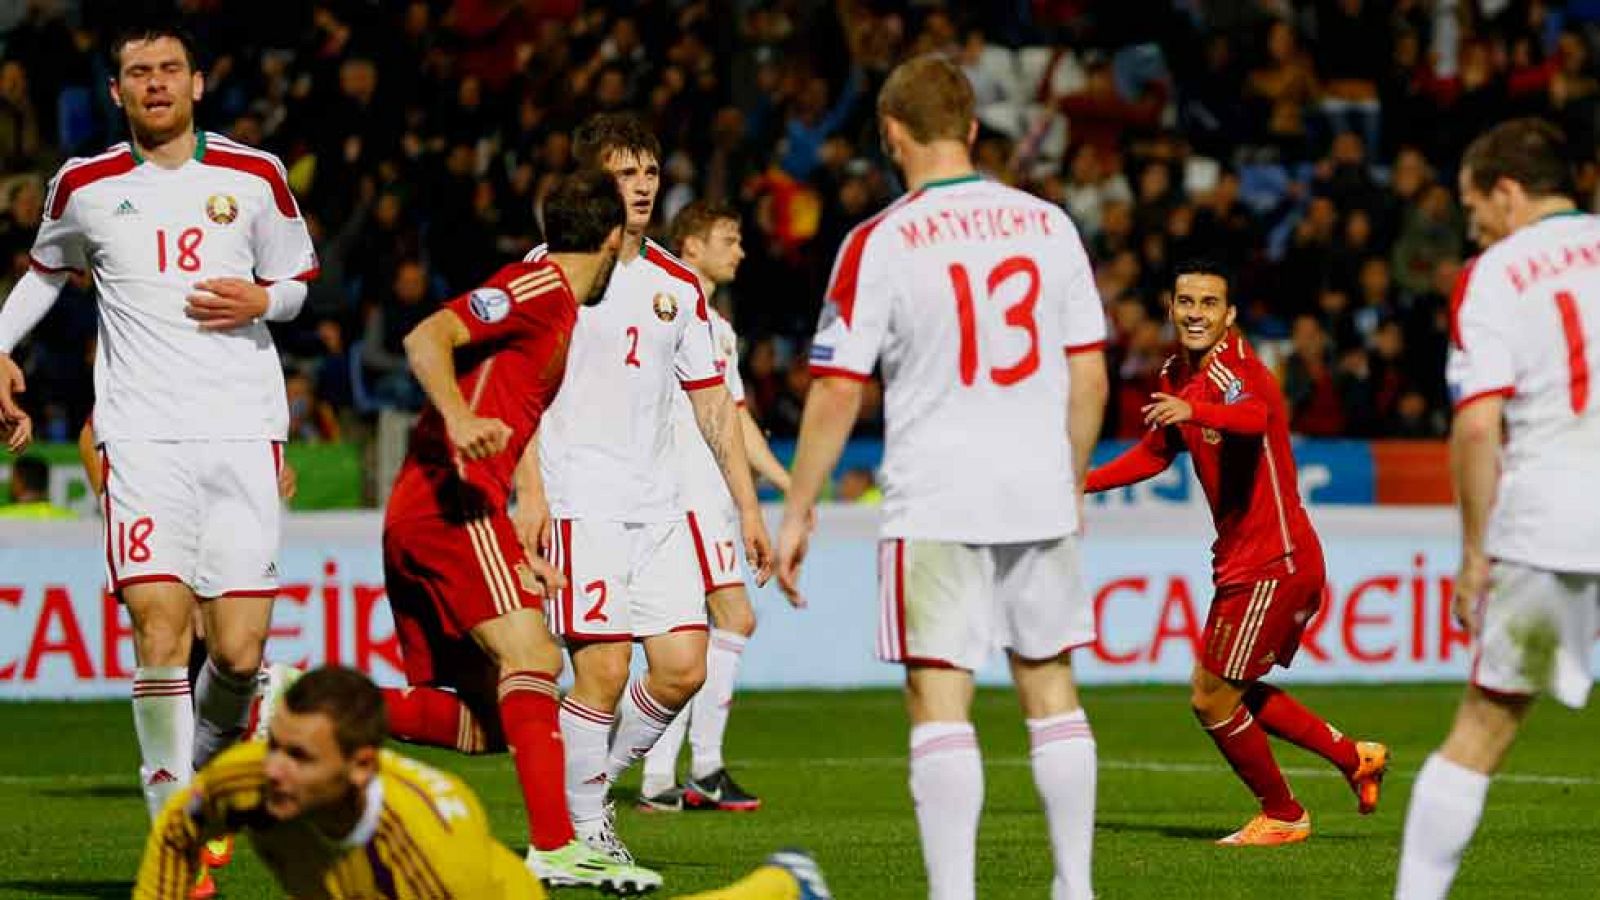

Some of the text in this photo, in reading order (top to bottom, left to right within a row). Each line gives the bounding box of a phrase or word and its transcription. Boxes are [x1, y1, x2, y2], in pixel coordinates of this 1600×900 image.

[156, 227, 203, 273] 18
[1506, 240, 1600, 294] BALAN
[949, 255, 1041, 387] 13
[625, 326, 641, 368] 2
[1554, 291, 1589, 415] 1
[118, 517, 154, 567] 18
[715, 540, 736, 573] 17
[584, 579, 608, 622] 2
